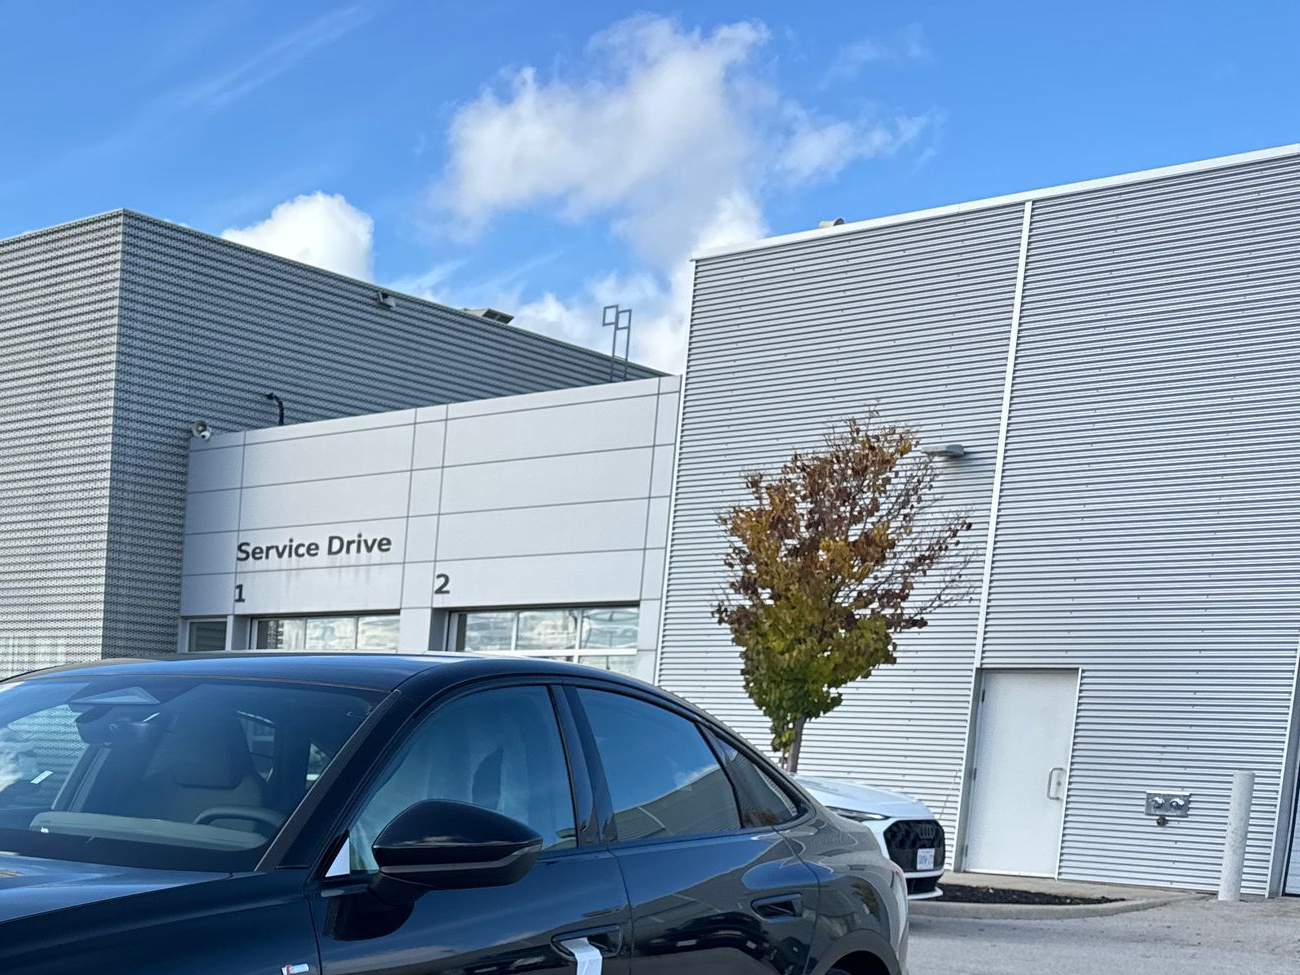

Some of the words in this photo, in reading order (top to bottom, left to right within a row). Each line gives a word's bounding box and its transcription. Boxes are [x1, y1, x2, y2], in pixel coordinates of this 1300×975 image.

[236, 538, 320, 562] Service
[327, 533, 392, 556] Drive
[234, 584, 246, 603] 1
[434, 573, 450, 595] 2
